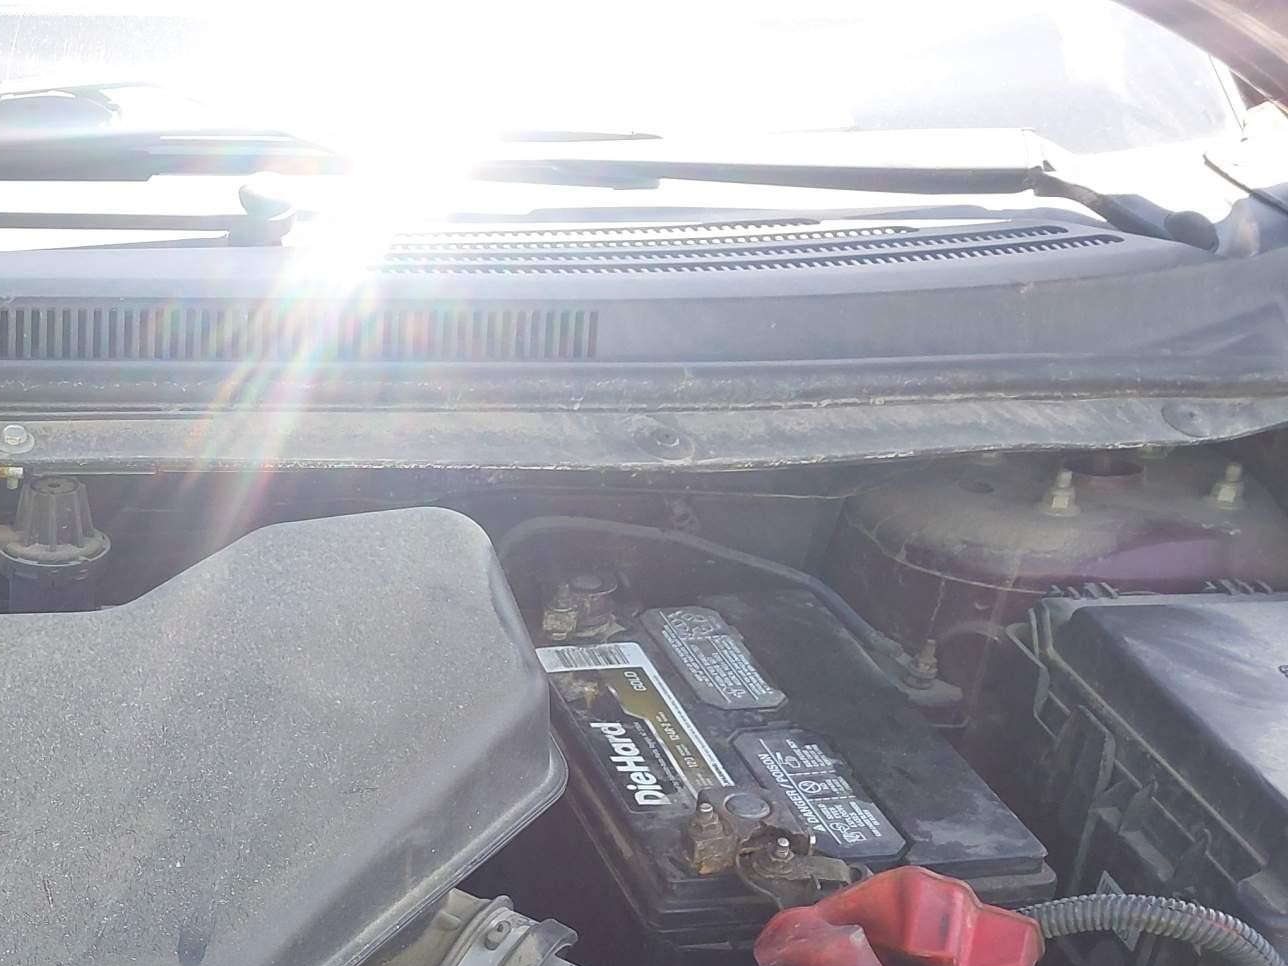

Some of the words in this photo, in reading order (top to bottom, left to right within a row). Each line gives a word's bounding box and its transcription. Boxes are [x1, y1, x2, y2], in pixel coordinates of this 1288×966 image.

[624, 671, 647, 692] GOLD
[589, 722, 672, 805] DieHard
[758, 753, 788, 783] POISON
[785, 790, 819, 824] DANGER
